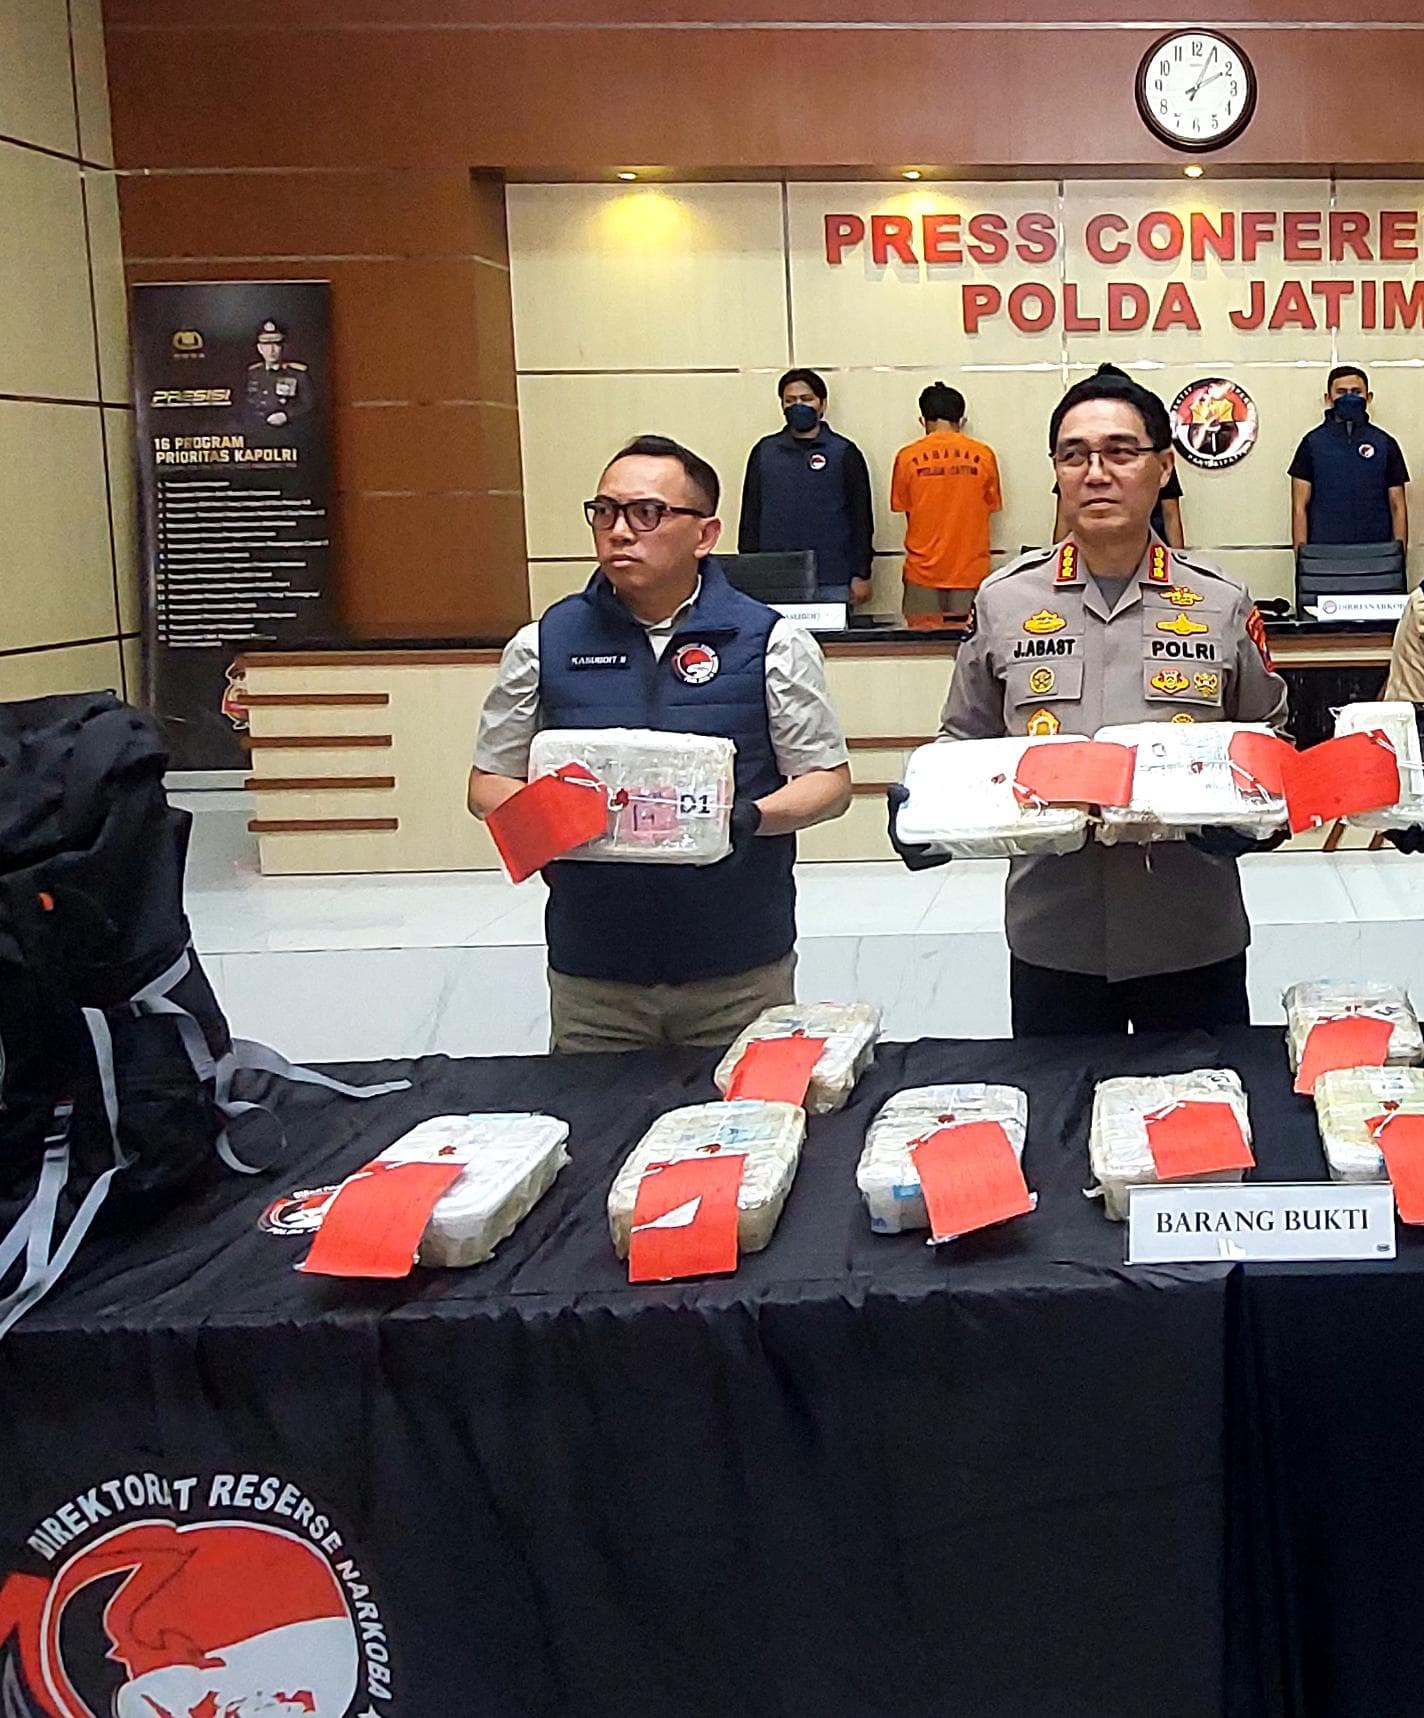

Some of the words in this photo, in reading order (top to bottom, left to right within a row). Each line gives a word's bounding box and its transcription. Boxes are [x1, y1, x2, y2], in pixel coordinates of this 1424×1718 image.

[1173, 45, 1182, 62] 11
[1191, 41, 1203, 57] 12
[1160, 60, 1170, 76] 10
[1225, 61, 1233, 77] 2
[1155, 79, 1163, 92] 9
[1230, 80, 1238, 97] 3
[1160, 98, 1168, 114] 8
[1211, 114, 1219, 130] 5
[824, 213, 1058, 265] PRESS
[961, 282, 1202, 334] POLDA
[152, 389, 231, 403] PRESISI
[154, 437, 171, 450] 16
[175, 435, 245, 450] PROGRAM
[156, 449, 230, 464] PRIORITAS
[234, 448, 298, 462] KAPOLRI
[1013, 638, 1076, 659] J.ABAST
[1151, 640, 1216, 661] POLRI
[680, 794, 711, 814] D1
[1156, 1210, 1275, 1233] BARANG
[1285, 1209, 1369, 1231] BUKTI
[208, 1474, 343, 1555] RESERSE
[334, 1559, 393, 1701] NARKOBA
